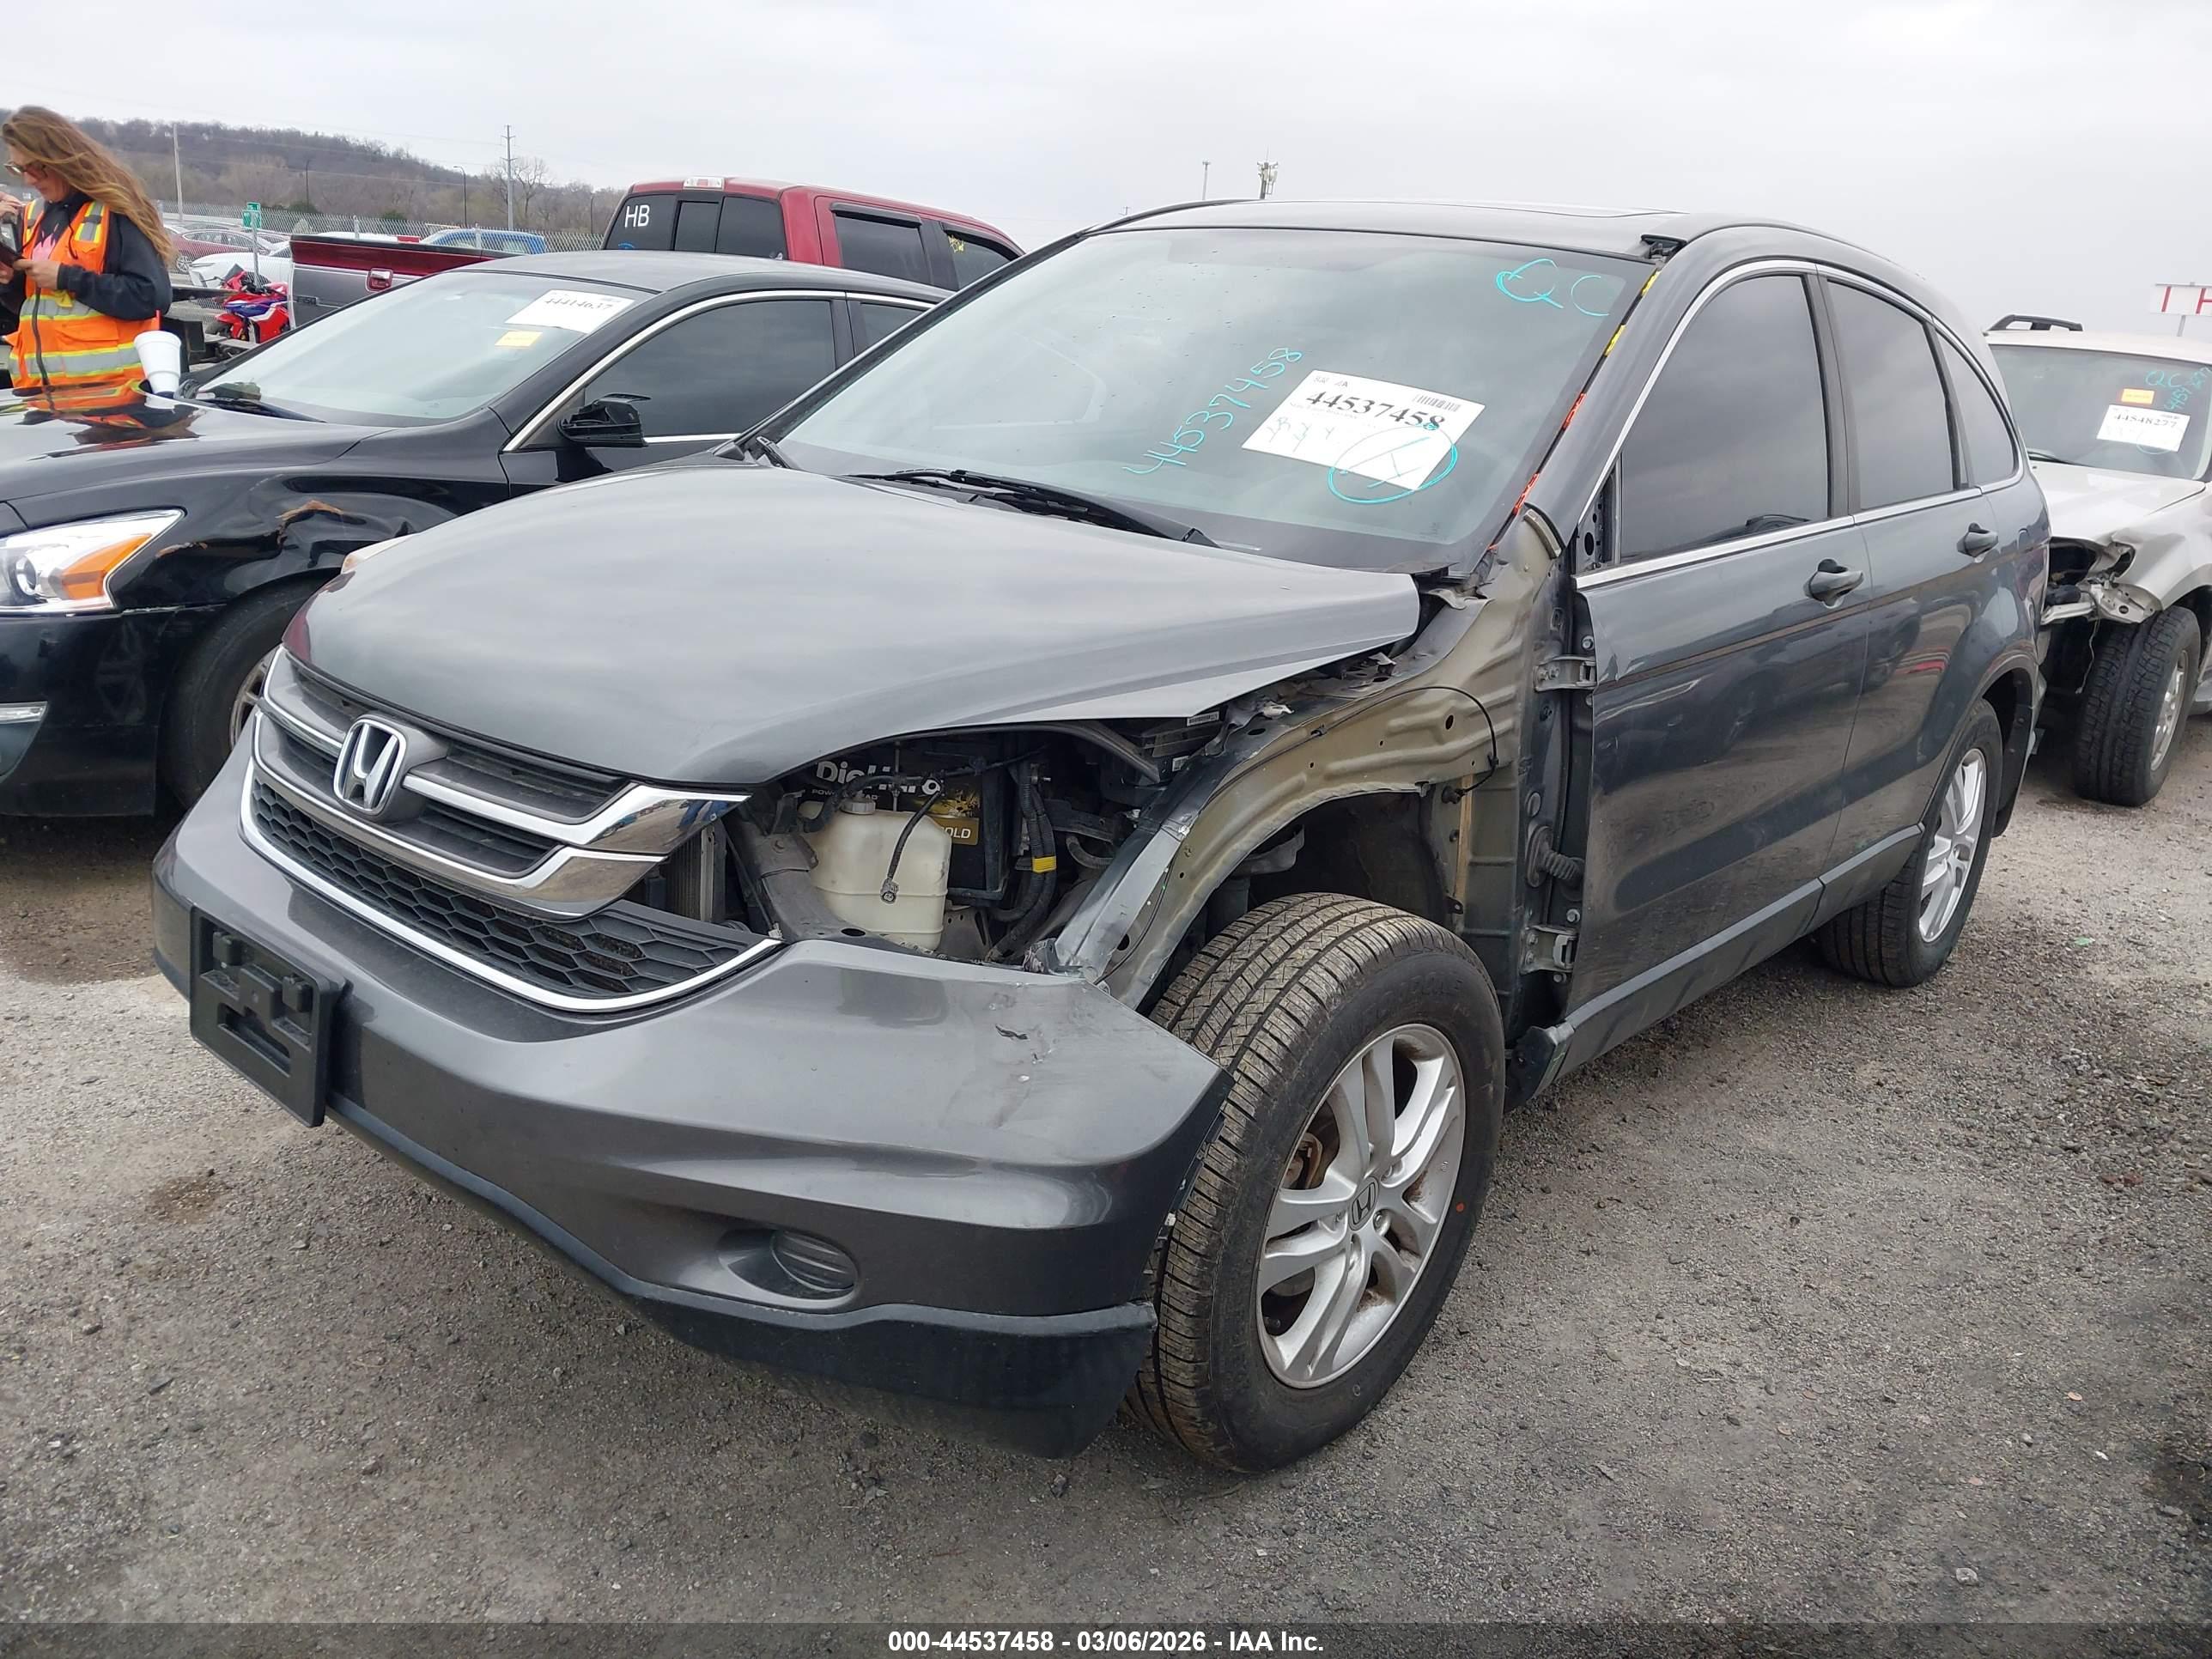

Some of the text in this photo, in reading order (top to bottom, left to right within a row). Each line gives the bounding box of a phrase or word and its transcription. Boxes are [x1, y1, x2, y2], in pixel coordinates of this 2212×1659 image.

[624, 204, 650, 228] HB
[1121, 347, 1303, 475] 44537458
[1305, 391, 1446, 431] 44537458
[941, 826, 971, 839] OLD
